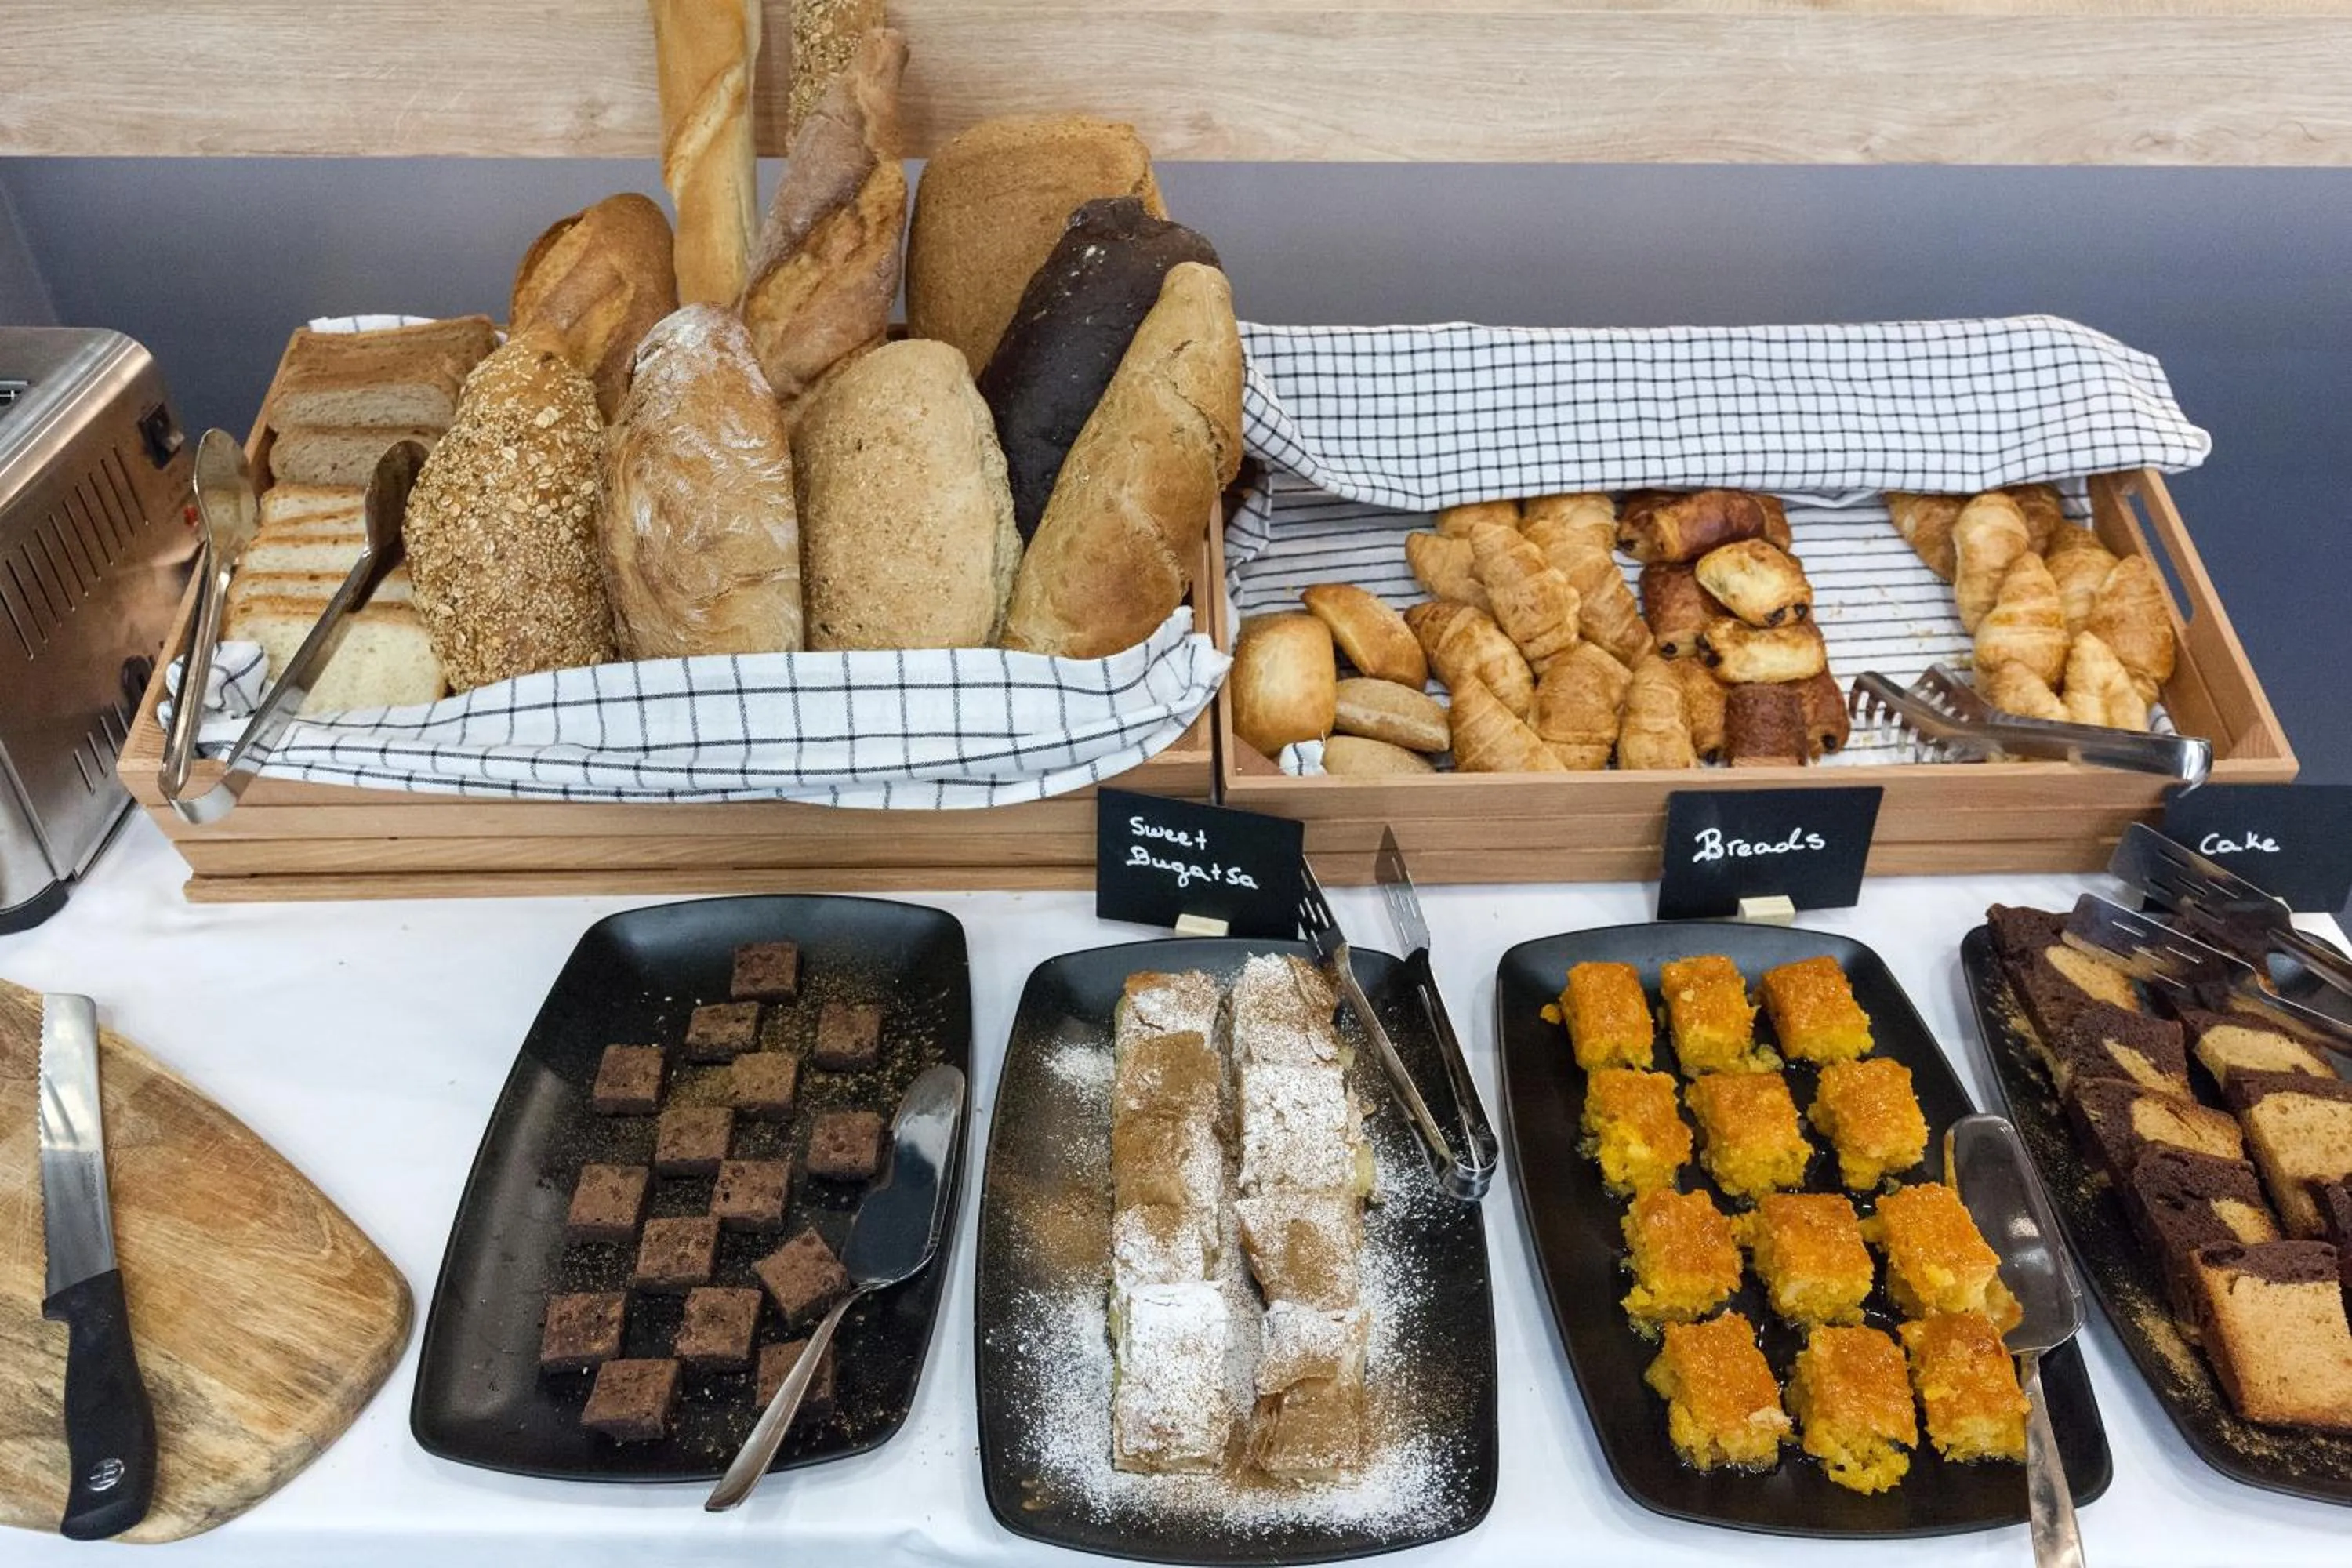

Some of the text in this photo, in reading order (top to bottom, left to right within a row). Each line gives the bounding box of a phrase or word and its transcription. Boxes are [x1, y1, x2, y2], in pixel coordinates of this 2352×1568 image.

[1128, 815, 1208, 851] Sweet
[1692, 826, 1827, 863] Breads
[2198, 831, 2281, 855] Cake
[1125, 844, 1259, 889] Bugatsa
